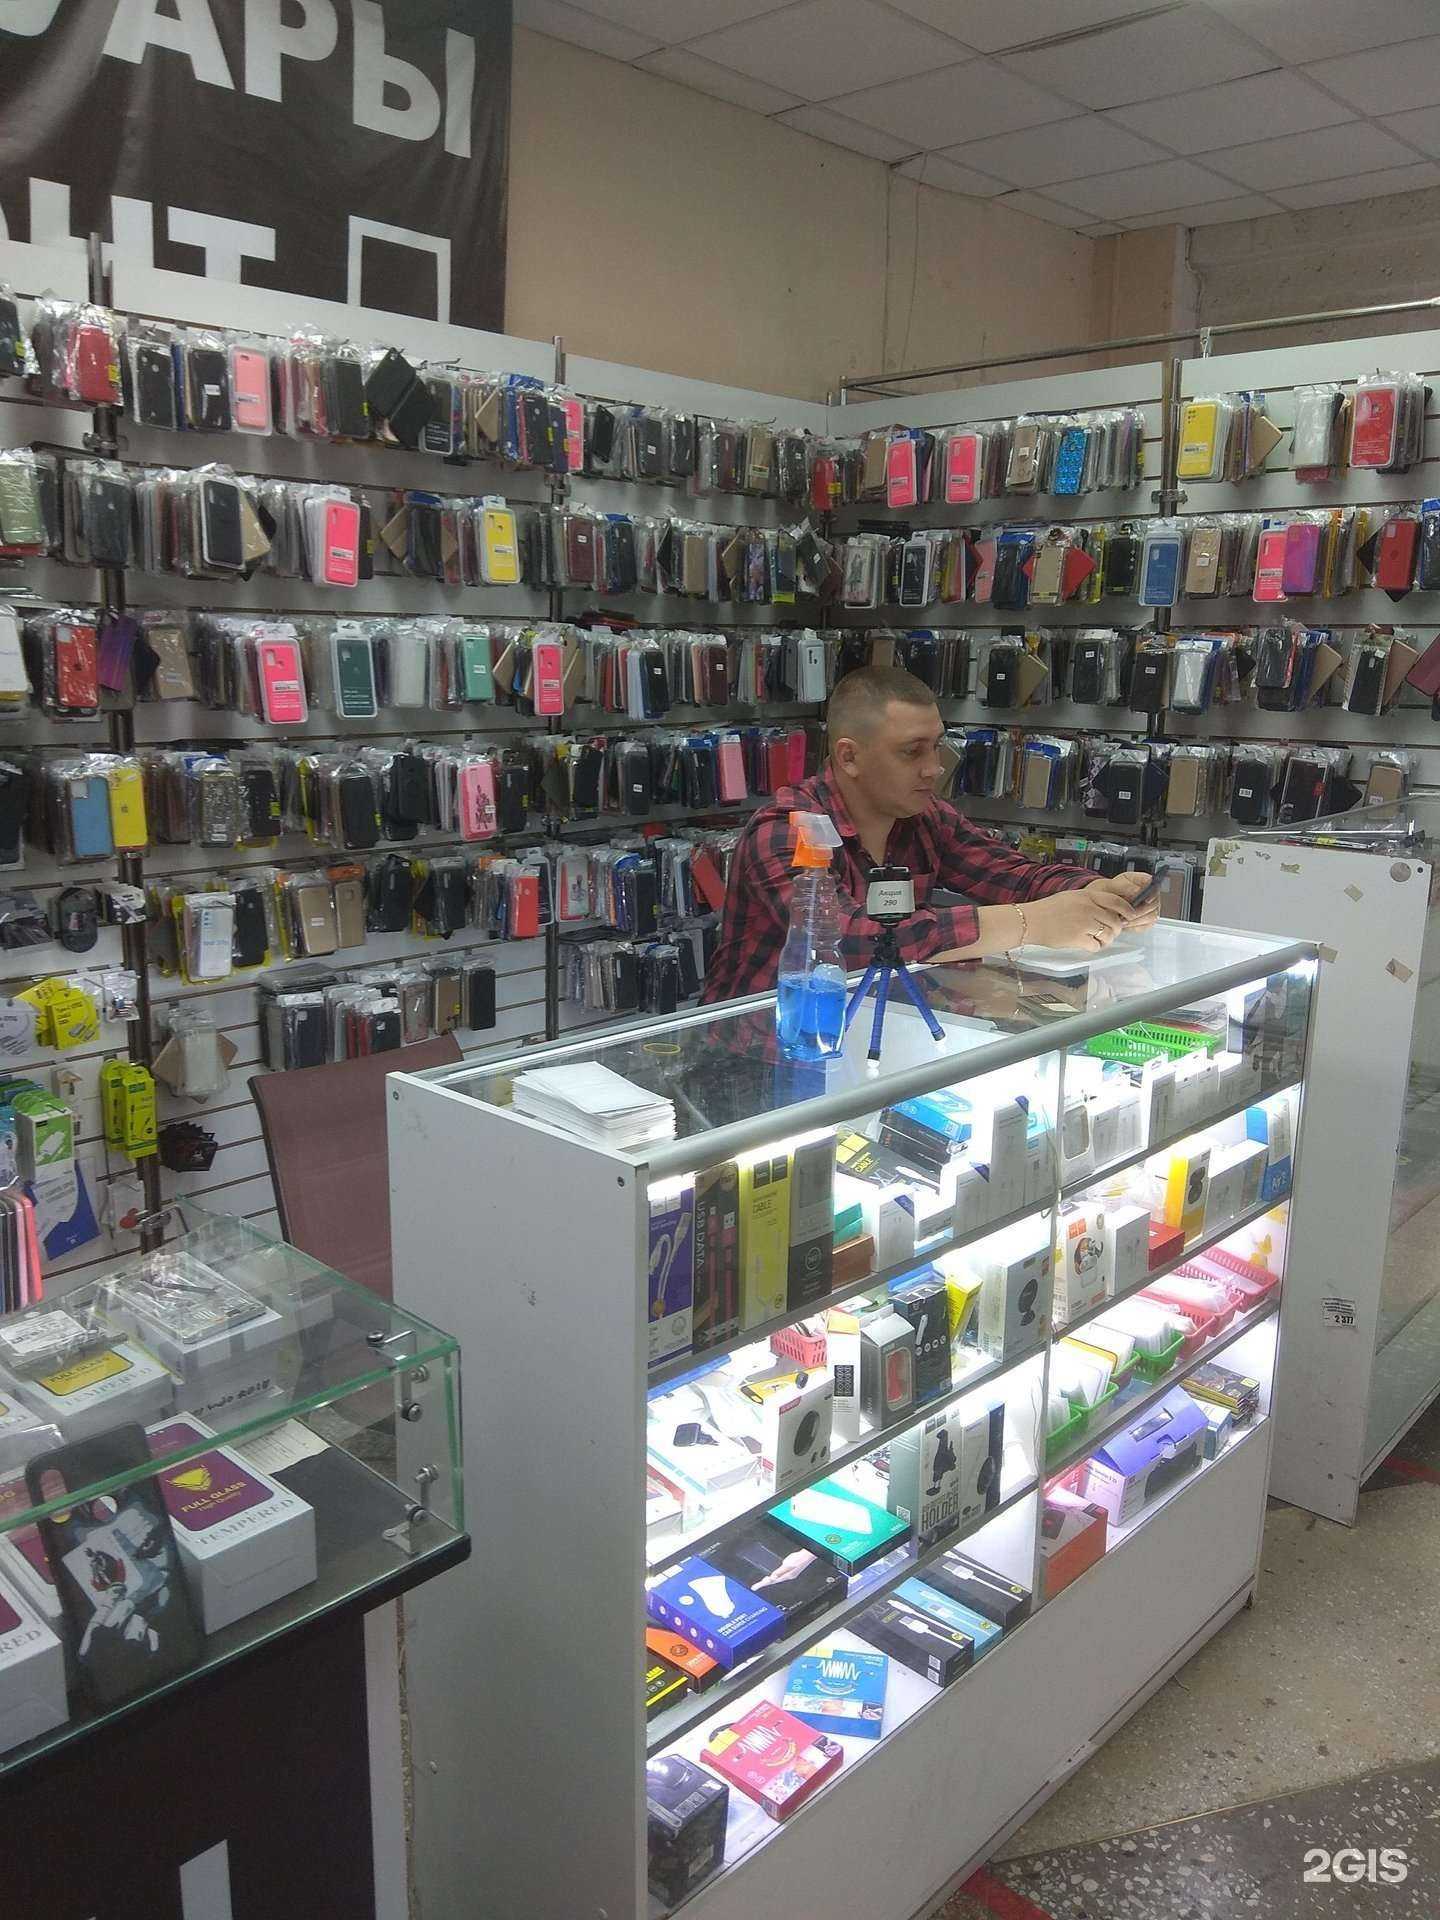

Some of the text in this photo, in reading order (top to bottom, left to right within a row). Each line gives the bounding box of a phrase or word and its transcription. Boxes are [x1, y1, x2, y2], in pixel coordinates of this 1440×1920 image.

[0, 0, 476, 158] АРЫ
[181, 1480, 248, 1514] FULL GLASS
[921, 1494, 959, 1533] HOLDER
[197, 1498, 295, 1546] TEMPERED
